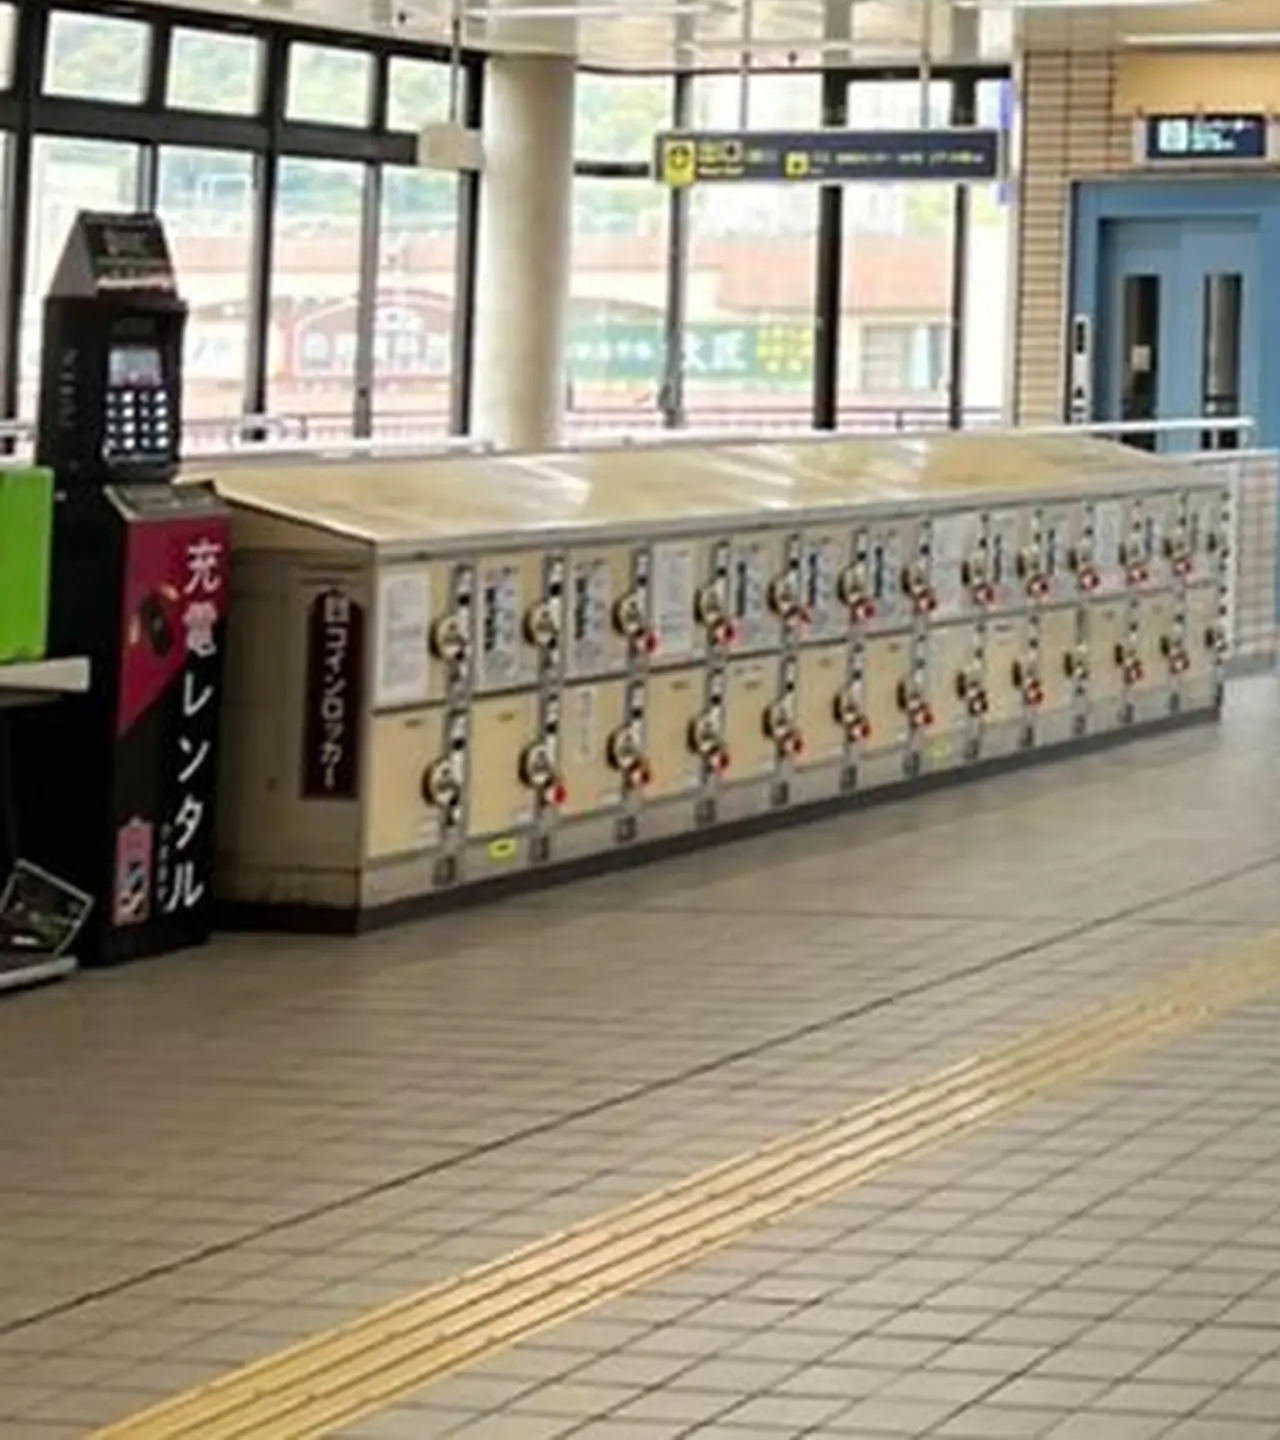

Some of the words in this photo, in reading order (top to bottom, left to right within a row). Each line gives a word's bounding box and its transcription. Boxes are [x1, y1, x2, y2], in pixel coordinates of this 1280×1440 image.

[164, 539, 223, 914] 充電レンタル
